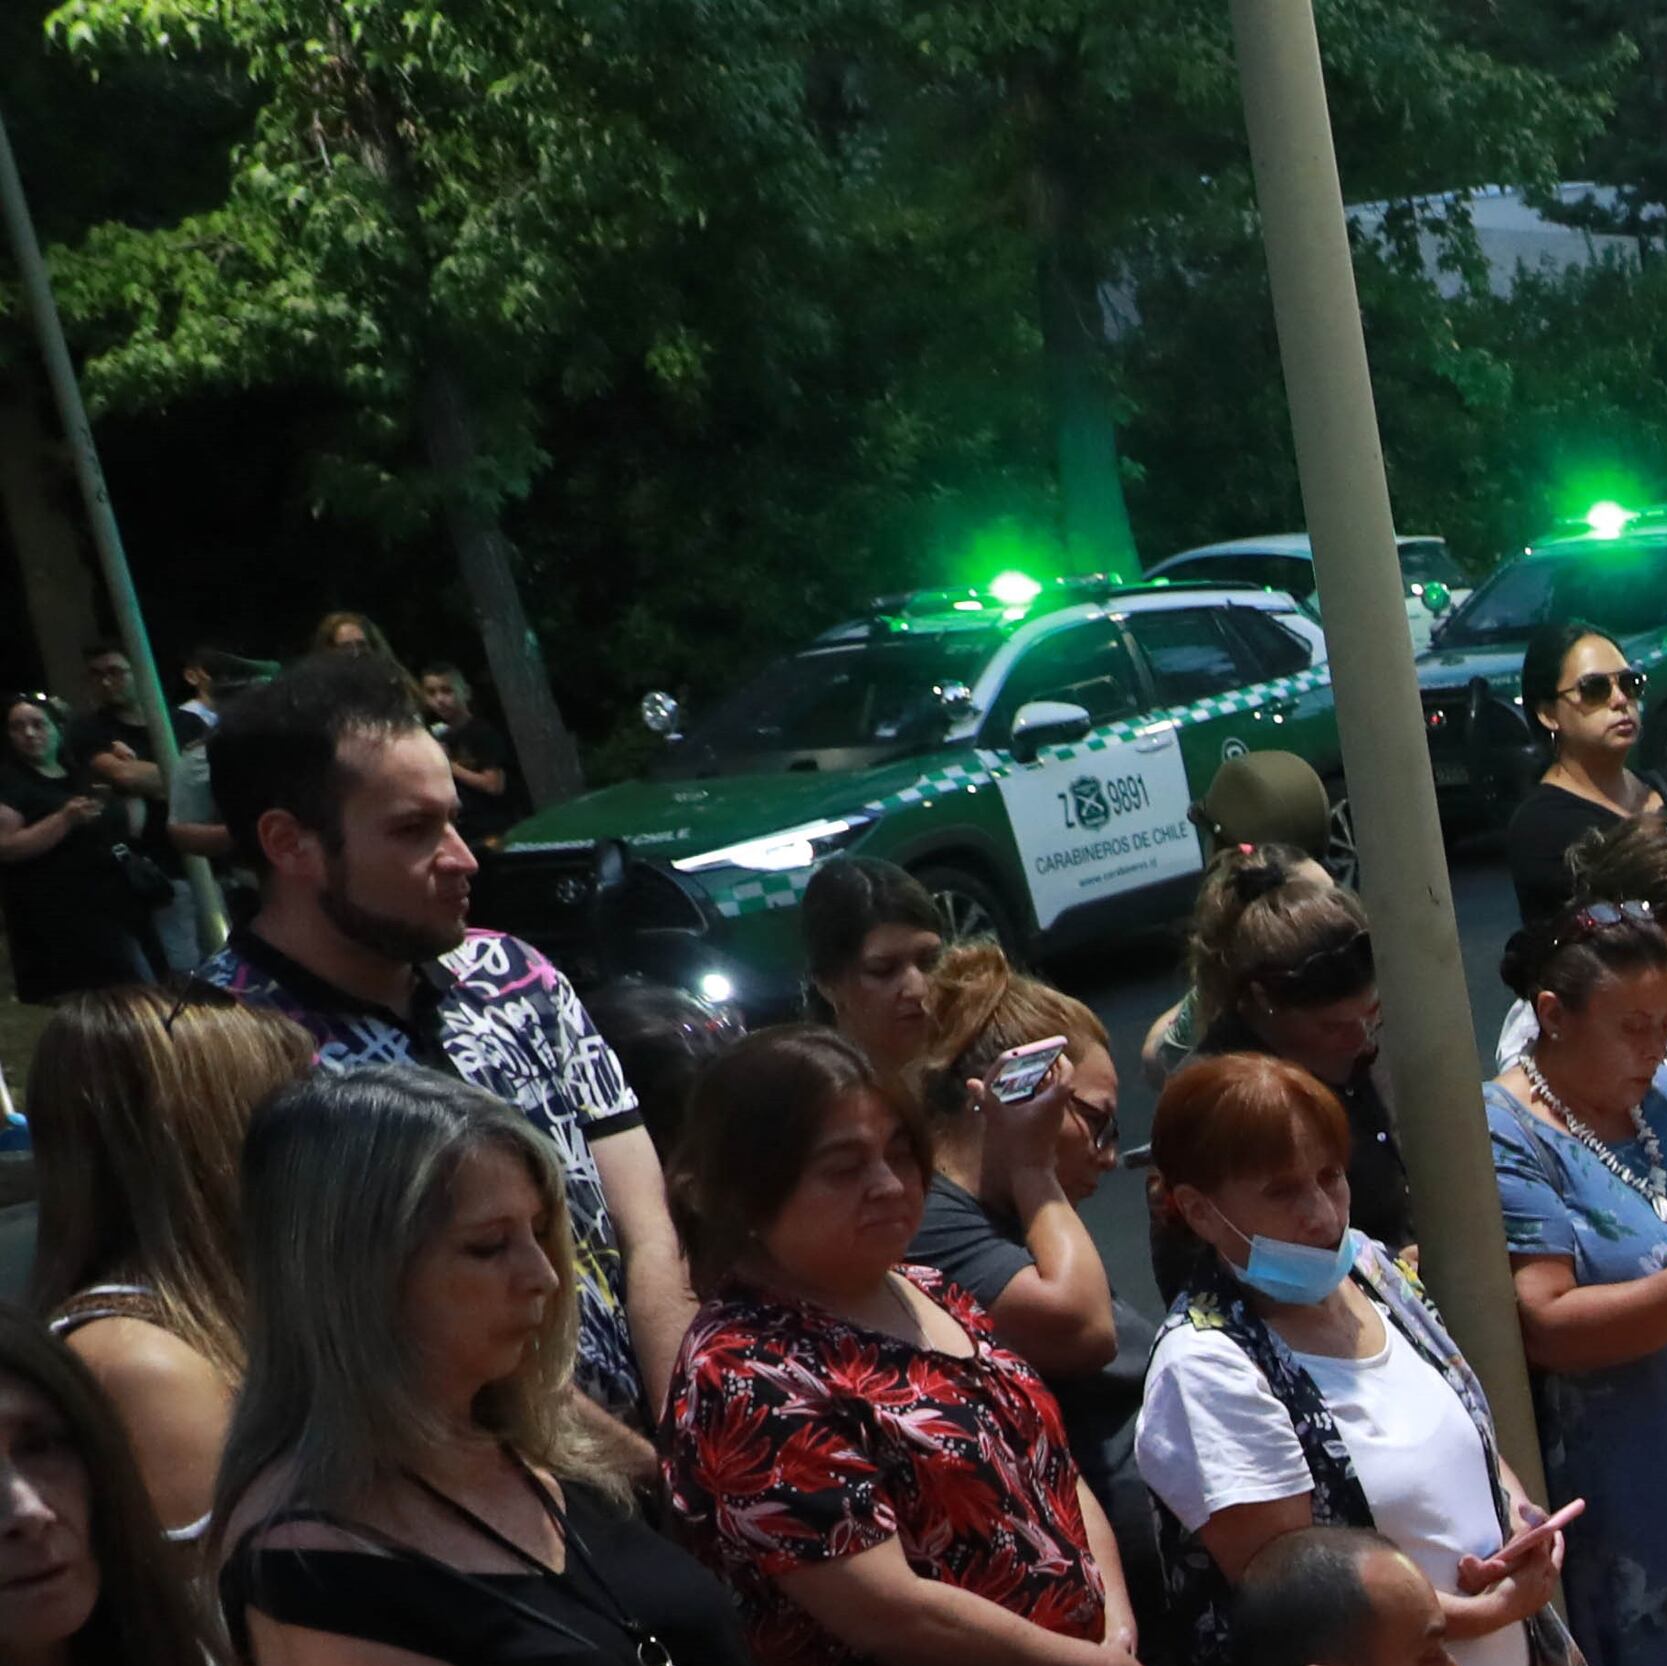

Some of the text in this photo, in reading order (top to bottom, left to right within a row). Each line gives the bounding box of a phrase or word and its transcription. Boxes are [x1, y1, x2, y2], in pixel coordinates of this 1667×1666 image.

[1057, 774, 1150, 828] Z 9891
[1035, 821, 1188, 874] CARABINEROS DE CHILE
